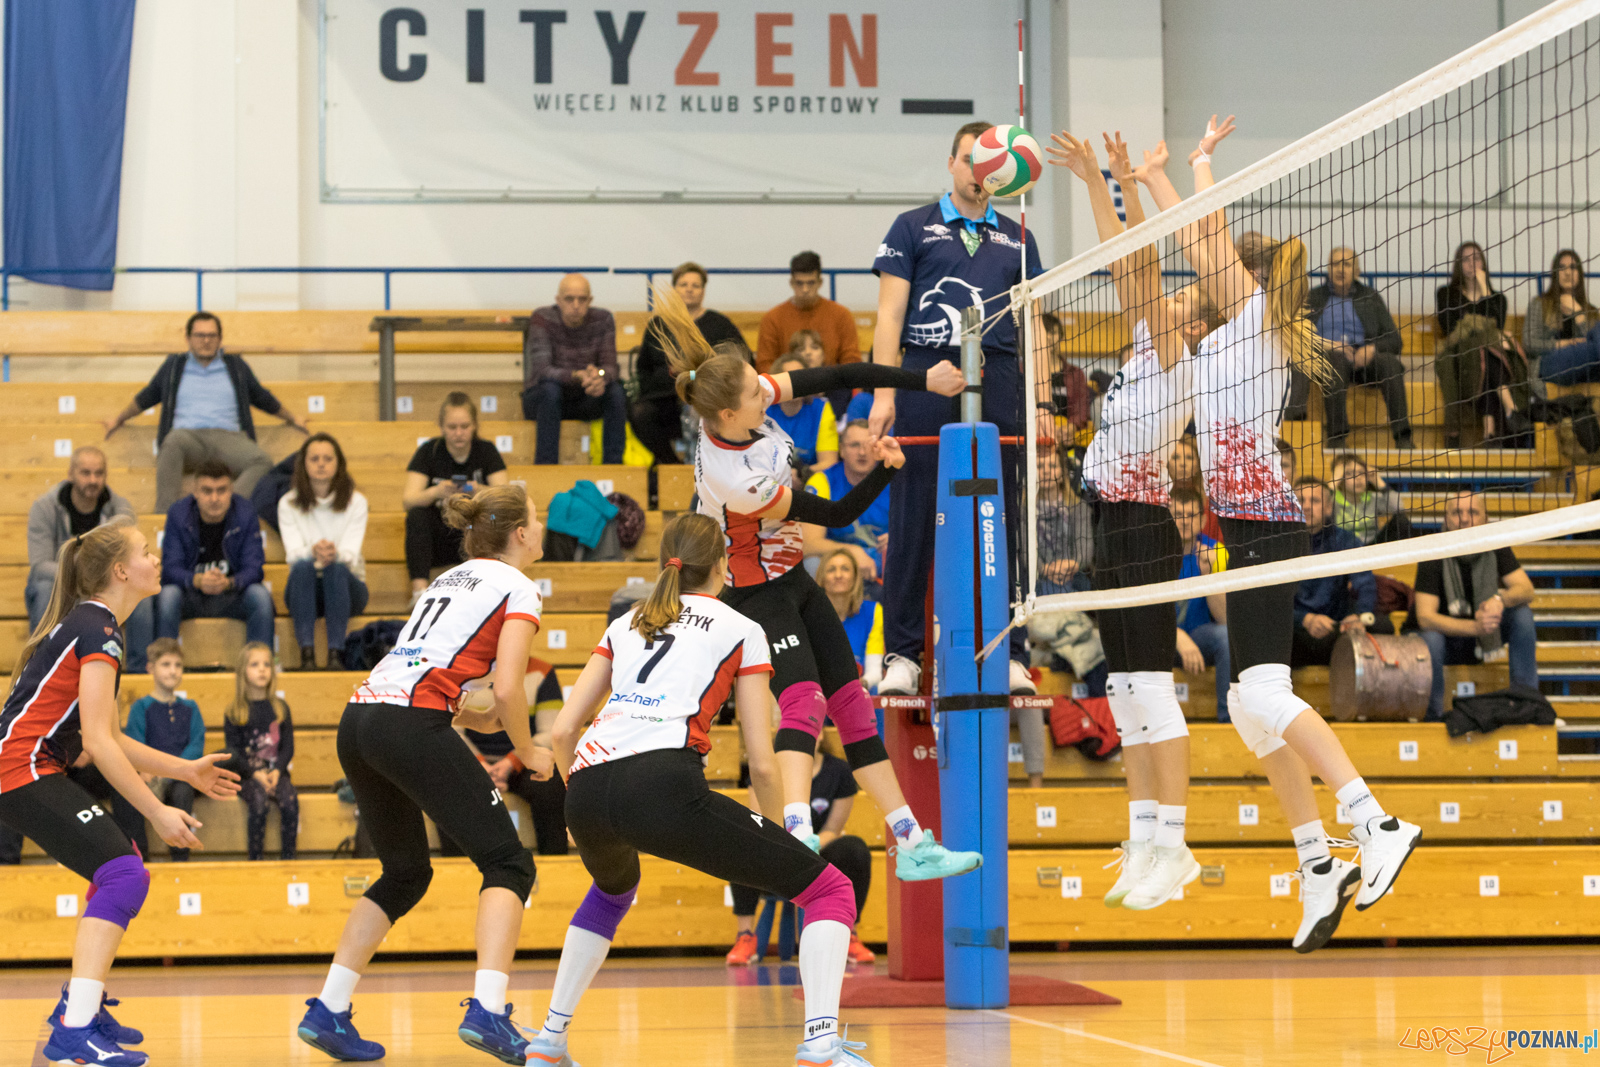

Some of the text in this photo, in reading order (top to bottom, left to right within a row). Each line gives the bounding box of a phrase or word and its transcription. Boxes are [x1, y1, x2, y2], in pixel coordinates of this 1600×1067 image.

[380, 8, 878, 88] CITYZEN
[534, 94, 879, 115] WIĘCEJ NIŻ KLUB SPORTOWY
[983, 519, 996, 577] Senoh
[407, 596, 451, 642] 11
[773, 634, 800, 655] NB
[637, 633, 676, 684] 7
[889, 698, 926, 708] Senoh
[1024, 697, 1054, 708] Senoh
[76, 804, 104, 824] DS
[1042, 811, 1052, 819] 14
[1244, 808, 1254, 817] 12
[1067, 881, 1077, 889] 14
[1275, 878, 1285, 888] 12
[1484, 880, 1494, 889] 10
[809, 1020, 831, 1036] gala
